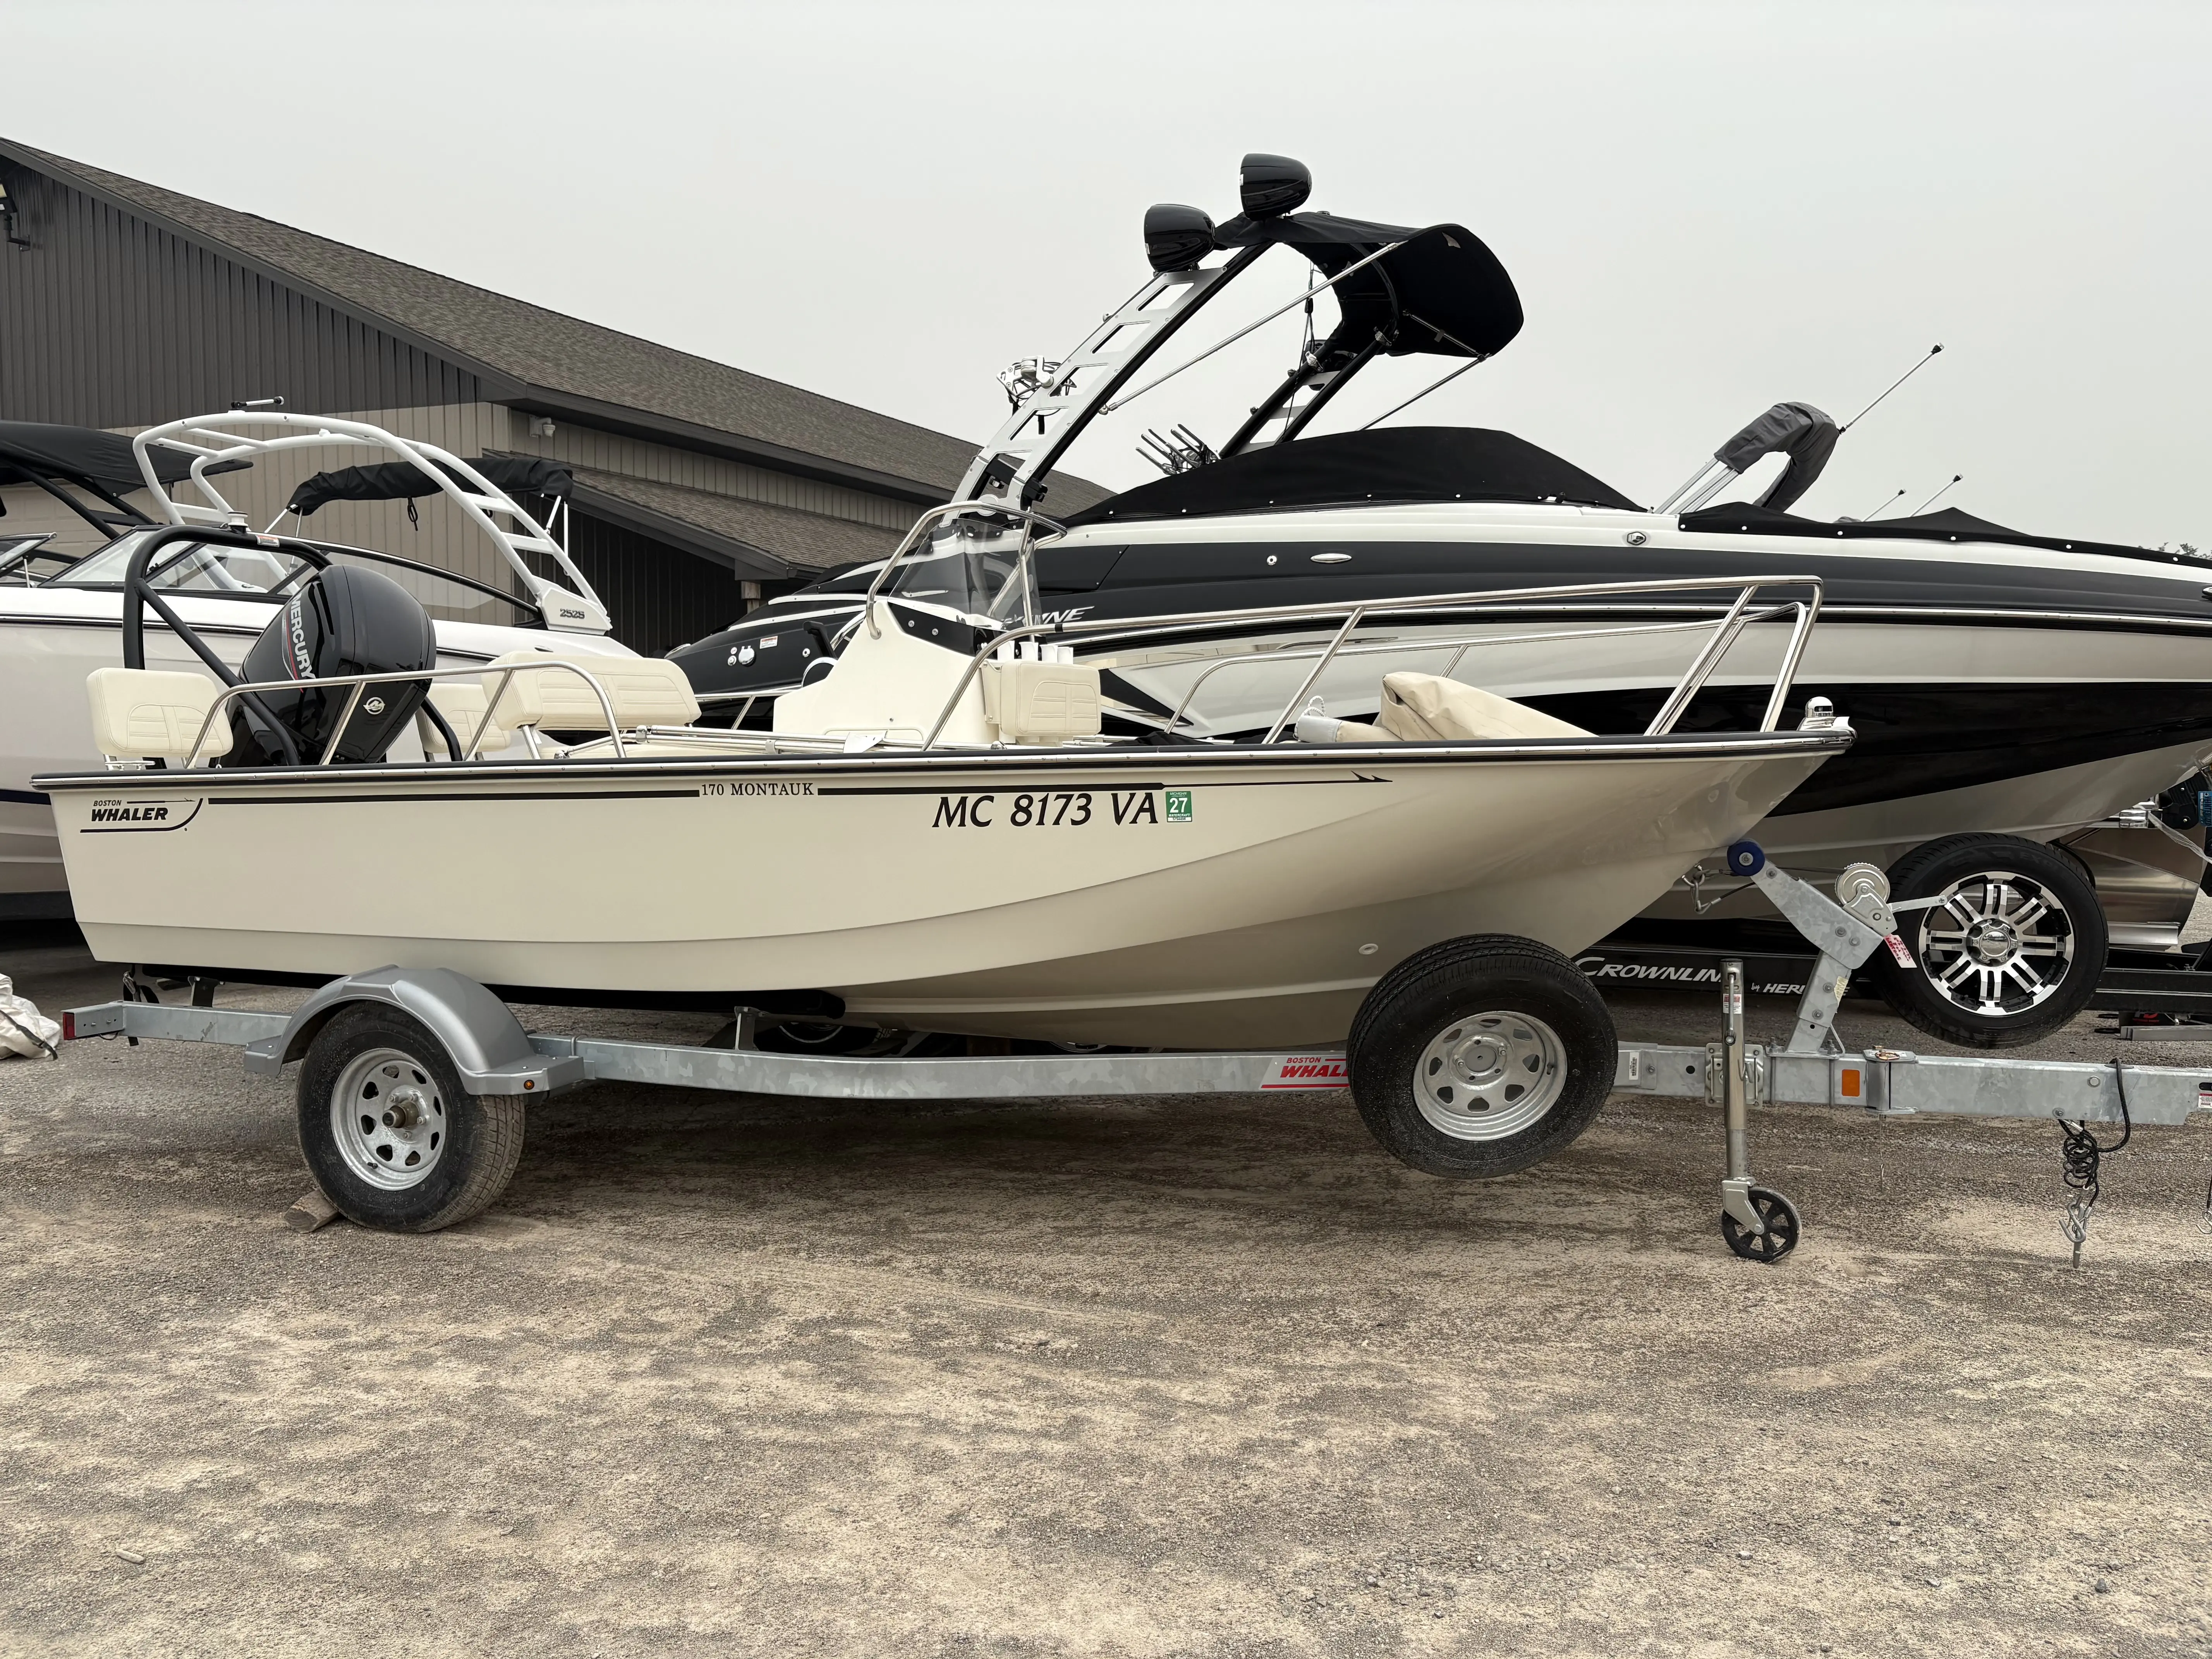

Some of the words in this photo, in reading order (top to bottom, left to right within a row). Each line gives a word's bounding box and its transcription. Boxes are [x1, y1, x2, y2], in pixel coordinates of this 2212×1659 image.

[291, 593, 316, 679] MERCURY
[702, 784, 724, 795] 170
[730, 783, 814, 795] MONTAUK
[932, 796, 994, 828] MC
[1010, 793, 1092, 826] 8173
[1111, 793, 1158, 826] VA
[1170, 798, 1187, 813] 27
[91, 807, 168, 821] WHALER
[1575, 957, 1721, 982] CROWNLIN
[1280, 1065, 1348, 1077] WHAL
